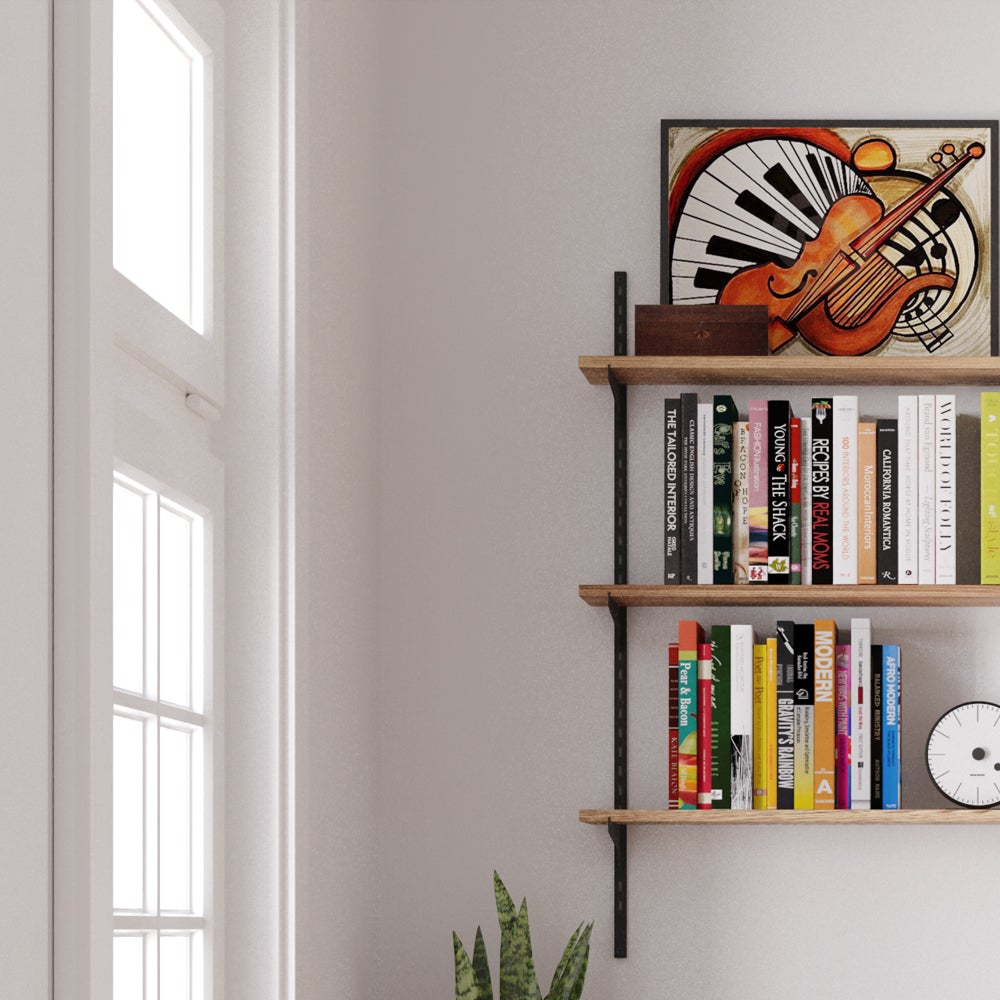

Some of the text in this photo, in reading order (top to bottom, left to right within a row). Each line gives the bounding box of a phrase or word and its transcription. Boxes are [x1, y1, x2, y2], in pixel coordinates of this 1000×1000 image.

[989, 415, 998, 423] A
[940, 402, 951, 466] WORLD
[667, 409, 676, 531] THE TAILORED INTERIOR
[714, 462, 732, 486] Eve
[772, 424, 787, 541] YOUNG THE SHACK
[812, 438, 829, 570] RECIPES BY REAL MOMS
[863, 465, 874, 550] Moroccan Interiors
[882, 449, 891, 550] CALIFORNIA ROMANTICA
[940, 500, 951, 551] FOLLY
[680, 662, 691, 684] Pear
[755, 656, 764, 674] Poet
[815, 631, 832, 702] MODERN
[838, 670, 848, 684] NEW
[755, 687, 764, 704] Poet
[838, 685, 848, 701] WAYS
[886, 656, 896, 725] AFRO MODERN
[680, 698, 691, 726] Bacon
[838, 702, 848, 716] WITH
[838, 717, 848, 735] PAINT
[778, 698, 794, 789] GRAVITY'S RAINBOW
[816, 780, 832, 794] A
